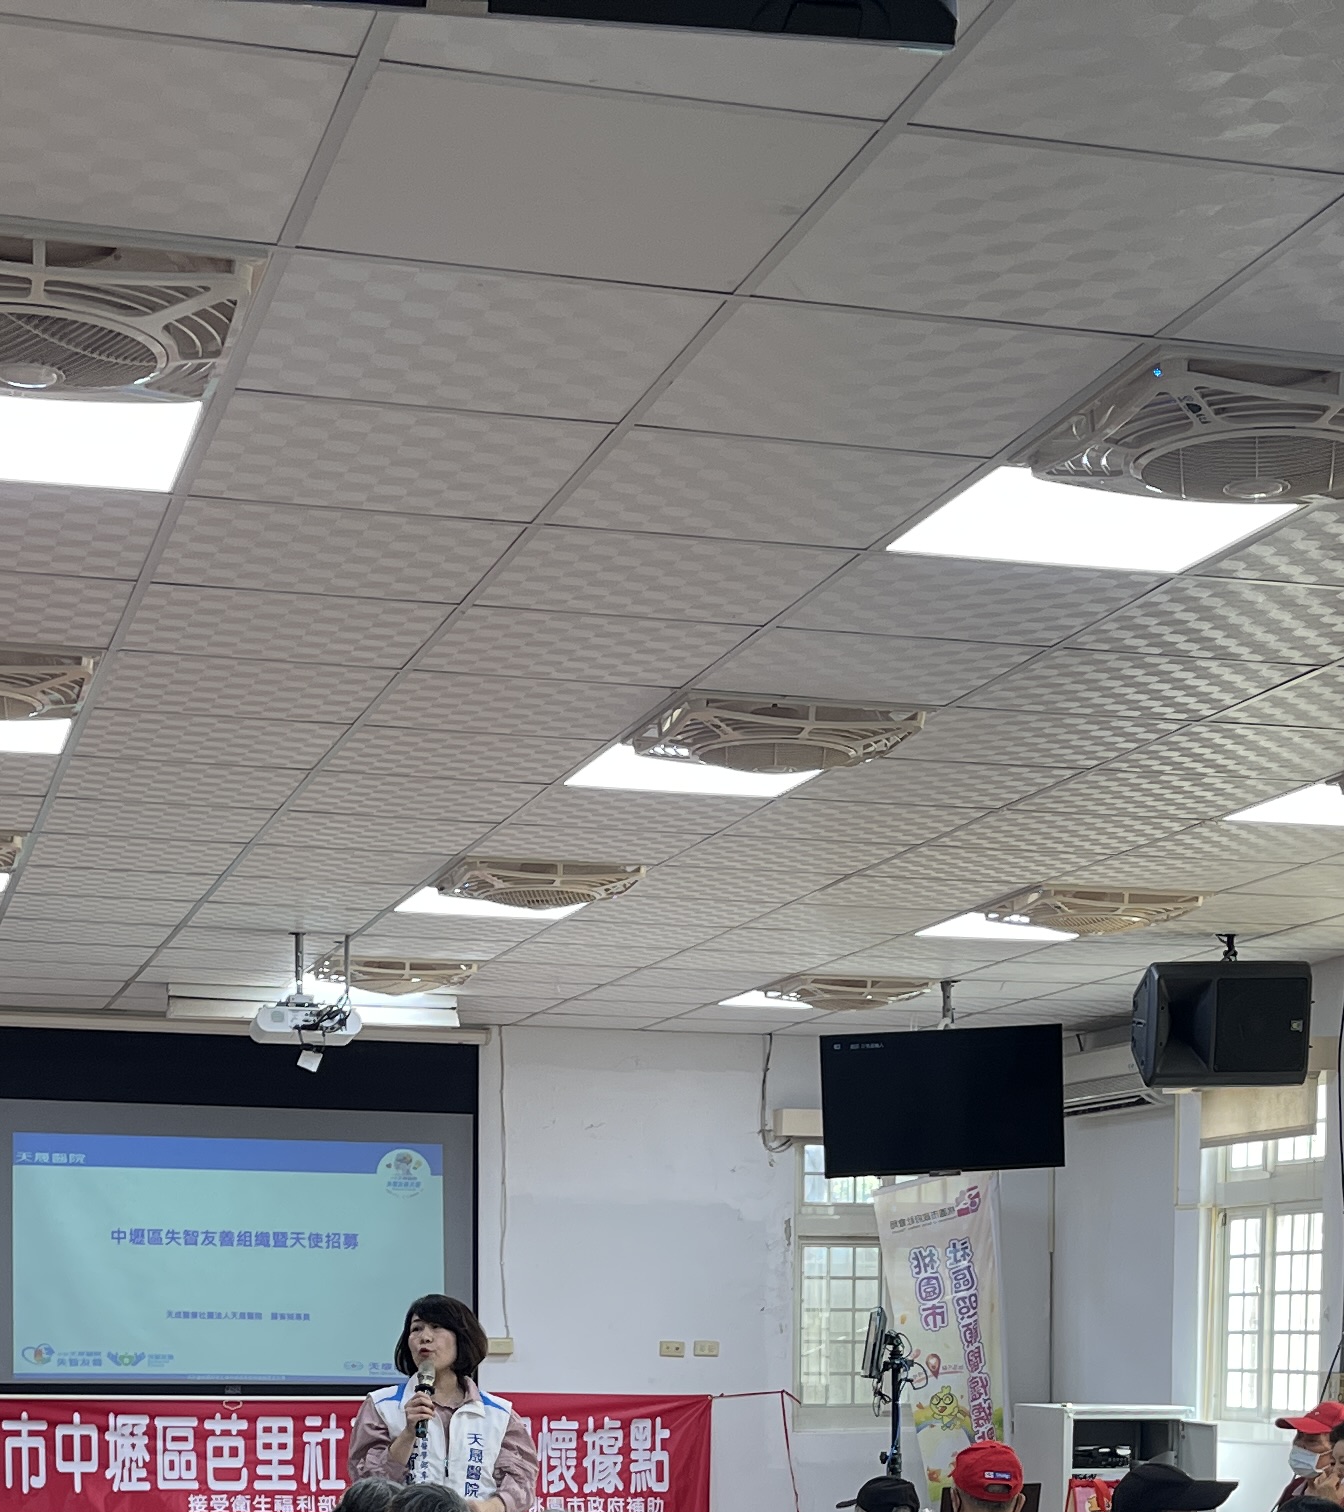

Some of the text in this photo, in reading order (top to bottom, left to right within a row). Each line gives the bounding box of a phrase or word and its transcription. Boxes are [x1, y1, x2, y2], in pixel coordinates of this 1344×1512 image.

[111, 1227, 359, 1250] 中壢區失智友善組織暨天使招募
[520, 1416, 670, 1494] 懷據點
